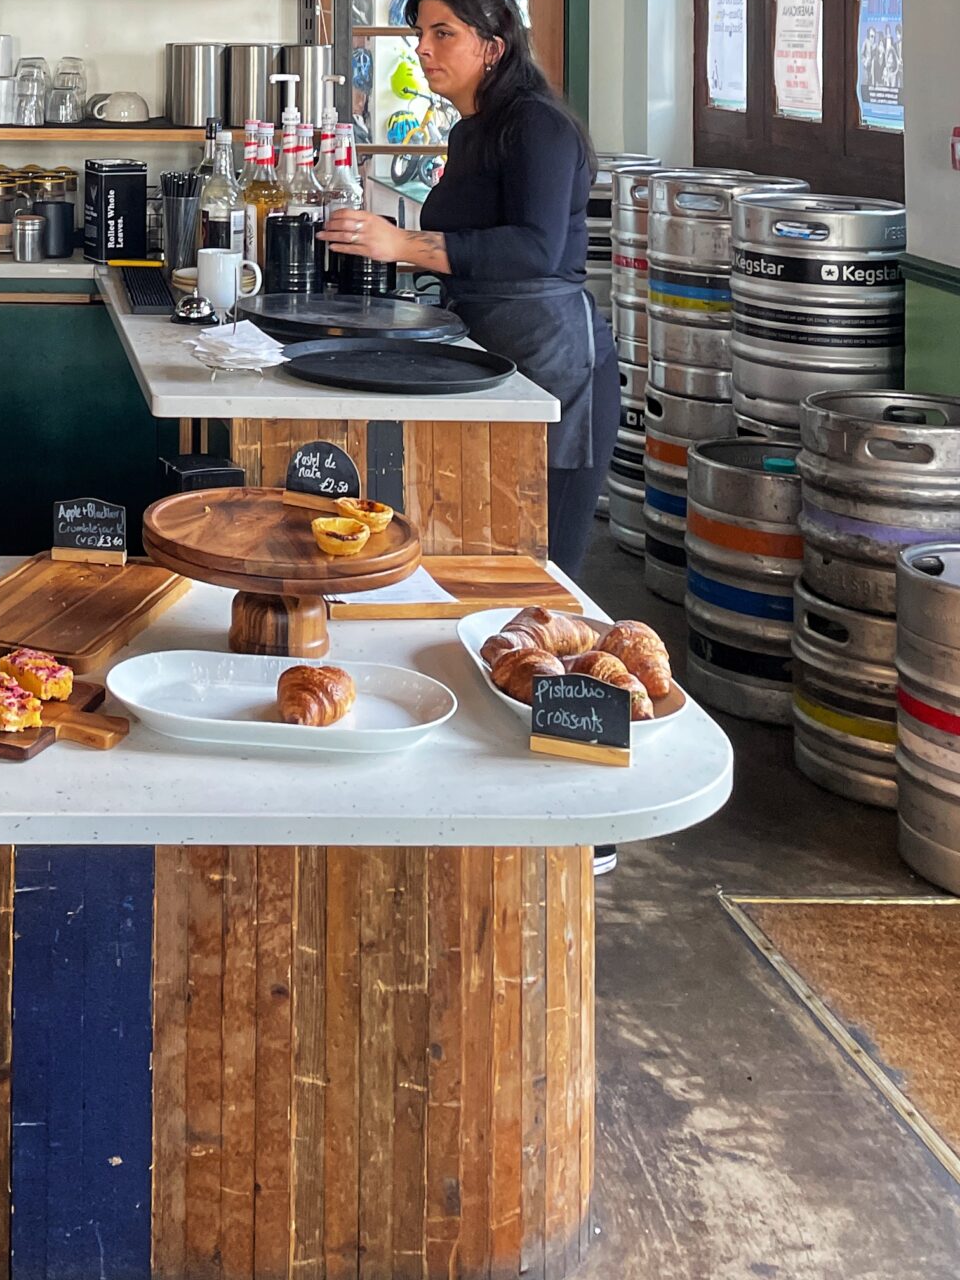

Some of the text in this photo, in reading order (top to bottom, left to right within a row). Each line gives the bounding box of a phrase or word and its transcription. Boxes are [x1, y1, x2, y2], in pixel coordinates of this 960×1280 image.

[107, 189, 116, 248] Rolled Whole
[116, 216, 124, 248] Leaves.
[735, 256, 784, 275] Kegstar
[842, 265, 902, 285] Kegstar
